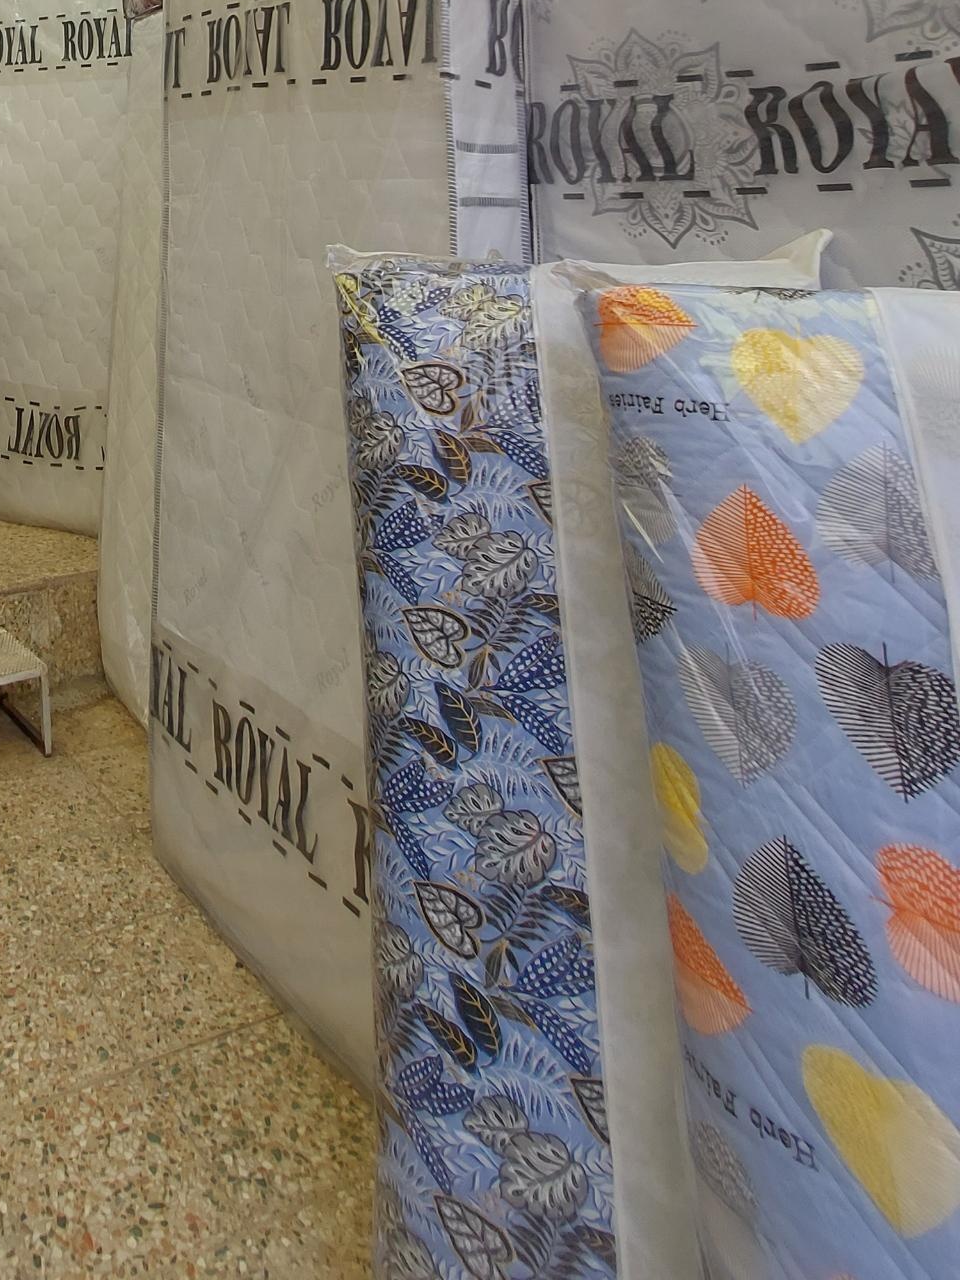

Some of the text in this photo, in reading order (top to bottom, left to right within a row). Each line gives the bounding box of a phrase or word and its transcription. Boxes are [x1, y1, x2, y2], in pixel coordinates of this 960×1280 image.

[529, 56, 960, 186] ROYAL ROYA
[674, 398, 731, 423] Herb
[212, 698, 319, 865] ROYAL
[749, 1106, 819, 1173] Herb
